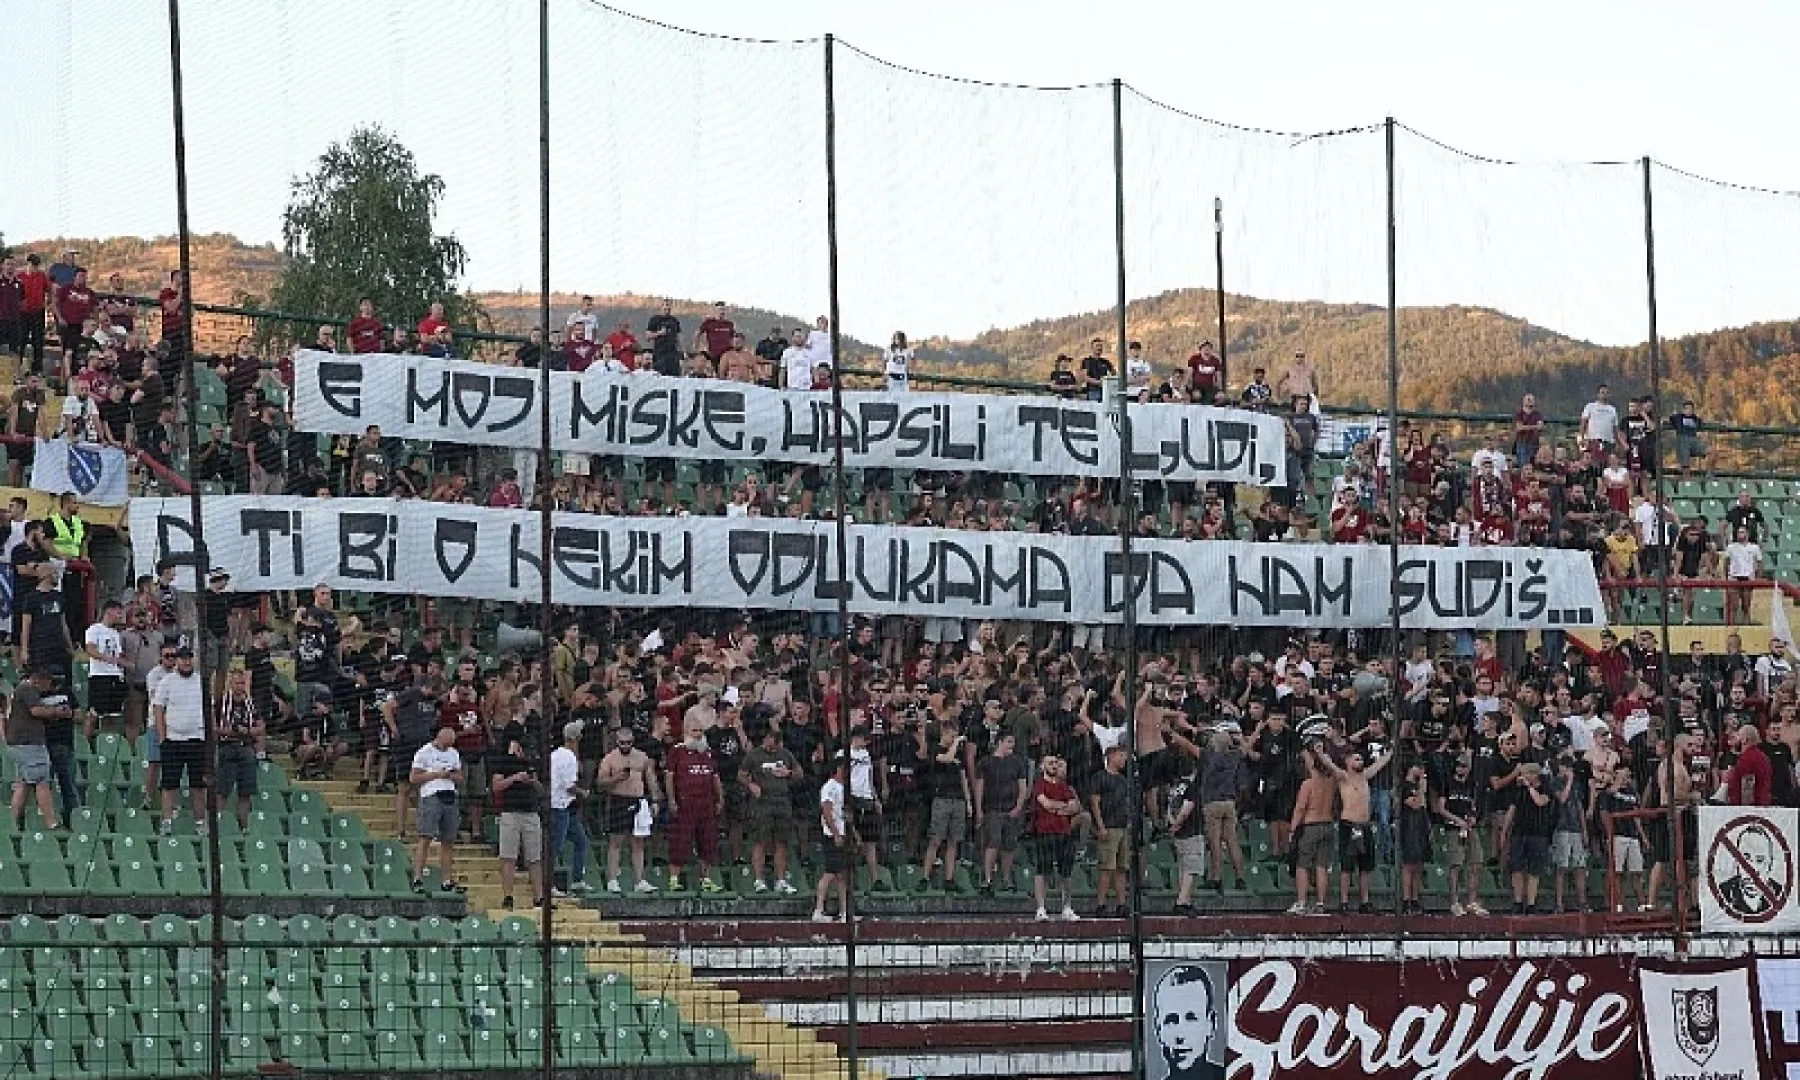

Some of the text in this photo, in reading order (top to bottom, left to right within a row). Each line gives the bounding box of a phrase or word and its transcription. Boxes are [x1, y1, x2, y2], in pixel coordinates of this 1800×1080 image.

[317, 361, 363, 418] E
[406, 366, 535, 433] MOJ
[1018, 403, 1099, 467] TE
[156, 515, 210, 576] A
[434, 517, 478, 583] O
[728, 529, 1072, 613] ODLUKAMA
[1104, 550, 1196, 615] DA
[1228, 554, 1353, 617] NAM
[1225, 959, 1636, 1080] Sarajlije
